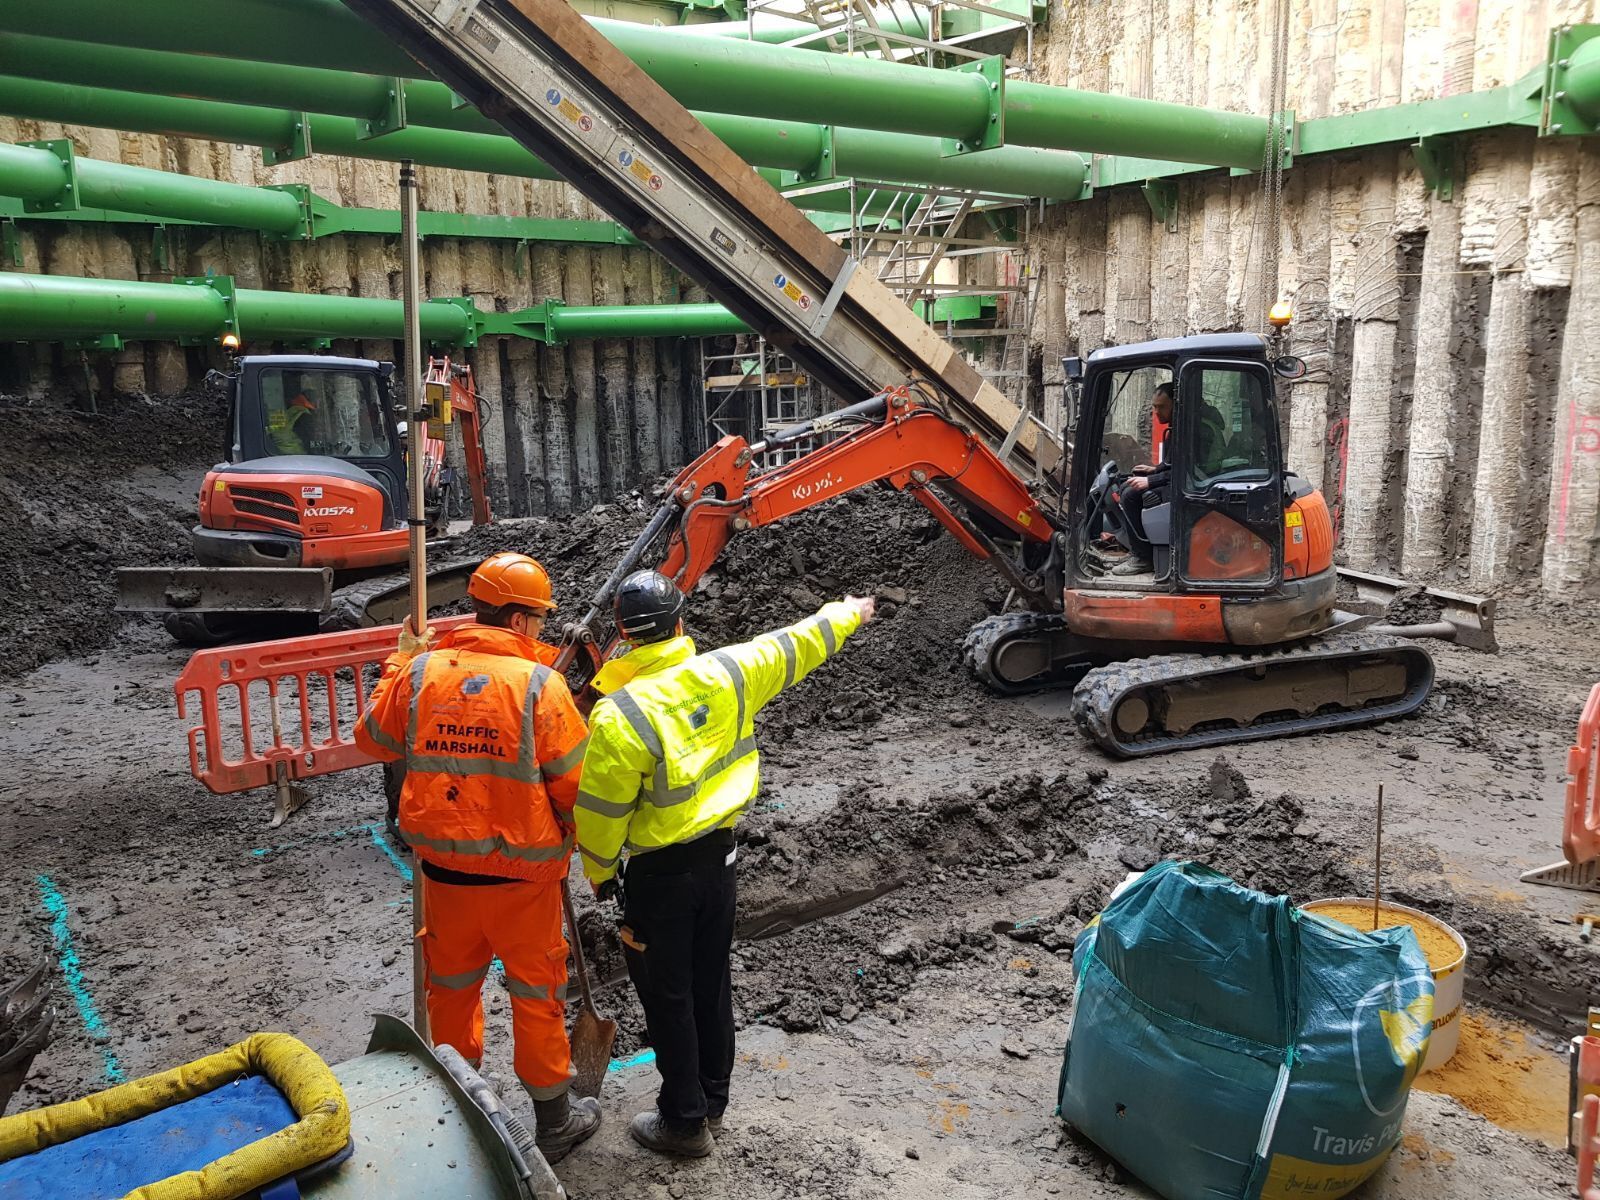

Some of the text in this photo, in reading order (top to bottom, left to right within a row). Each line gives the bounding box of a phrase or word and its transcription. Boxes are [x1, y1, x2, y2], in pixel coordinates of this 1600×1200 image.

[437, 723, 499, 740] TRAFFIC
[425, 740, 506, 757] MARSHALL
[1312, 1125, 1376, 1156] Travis
